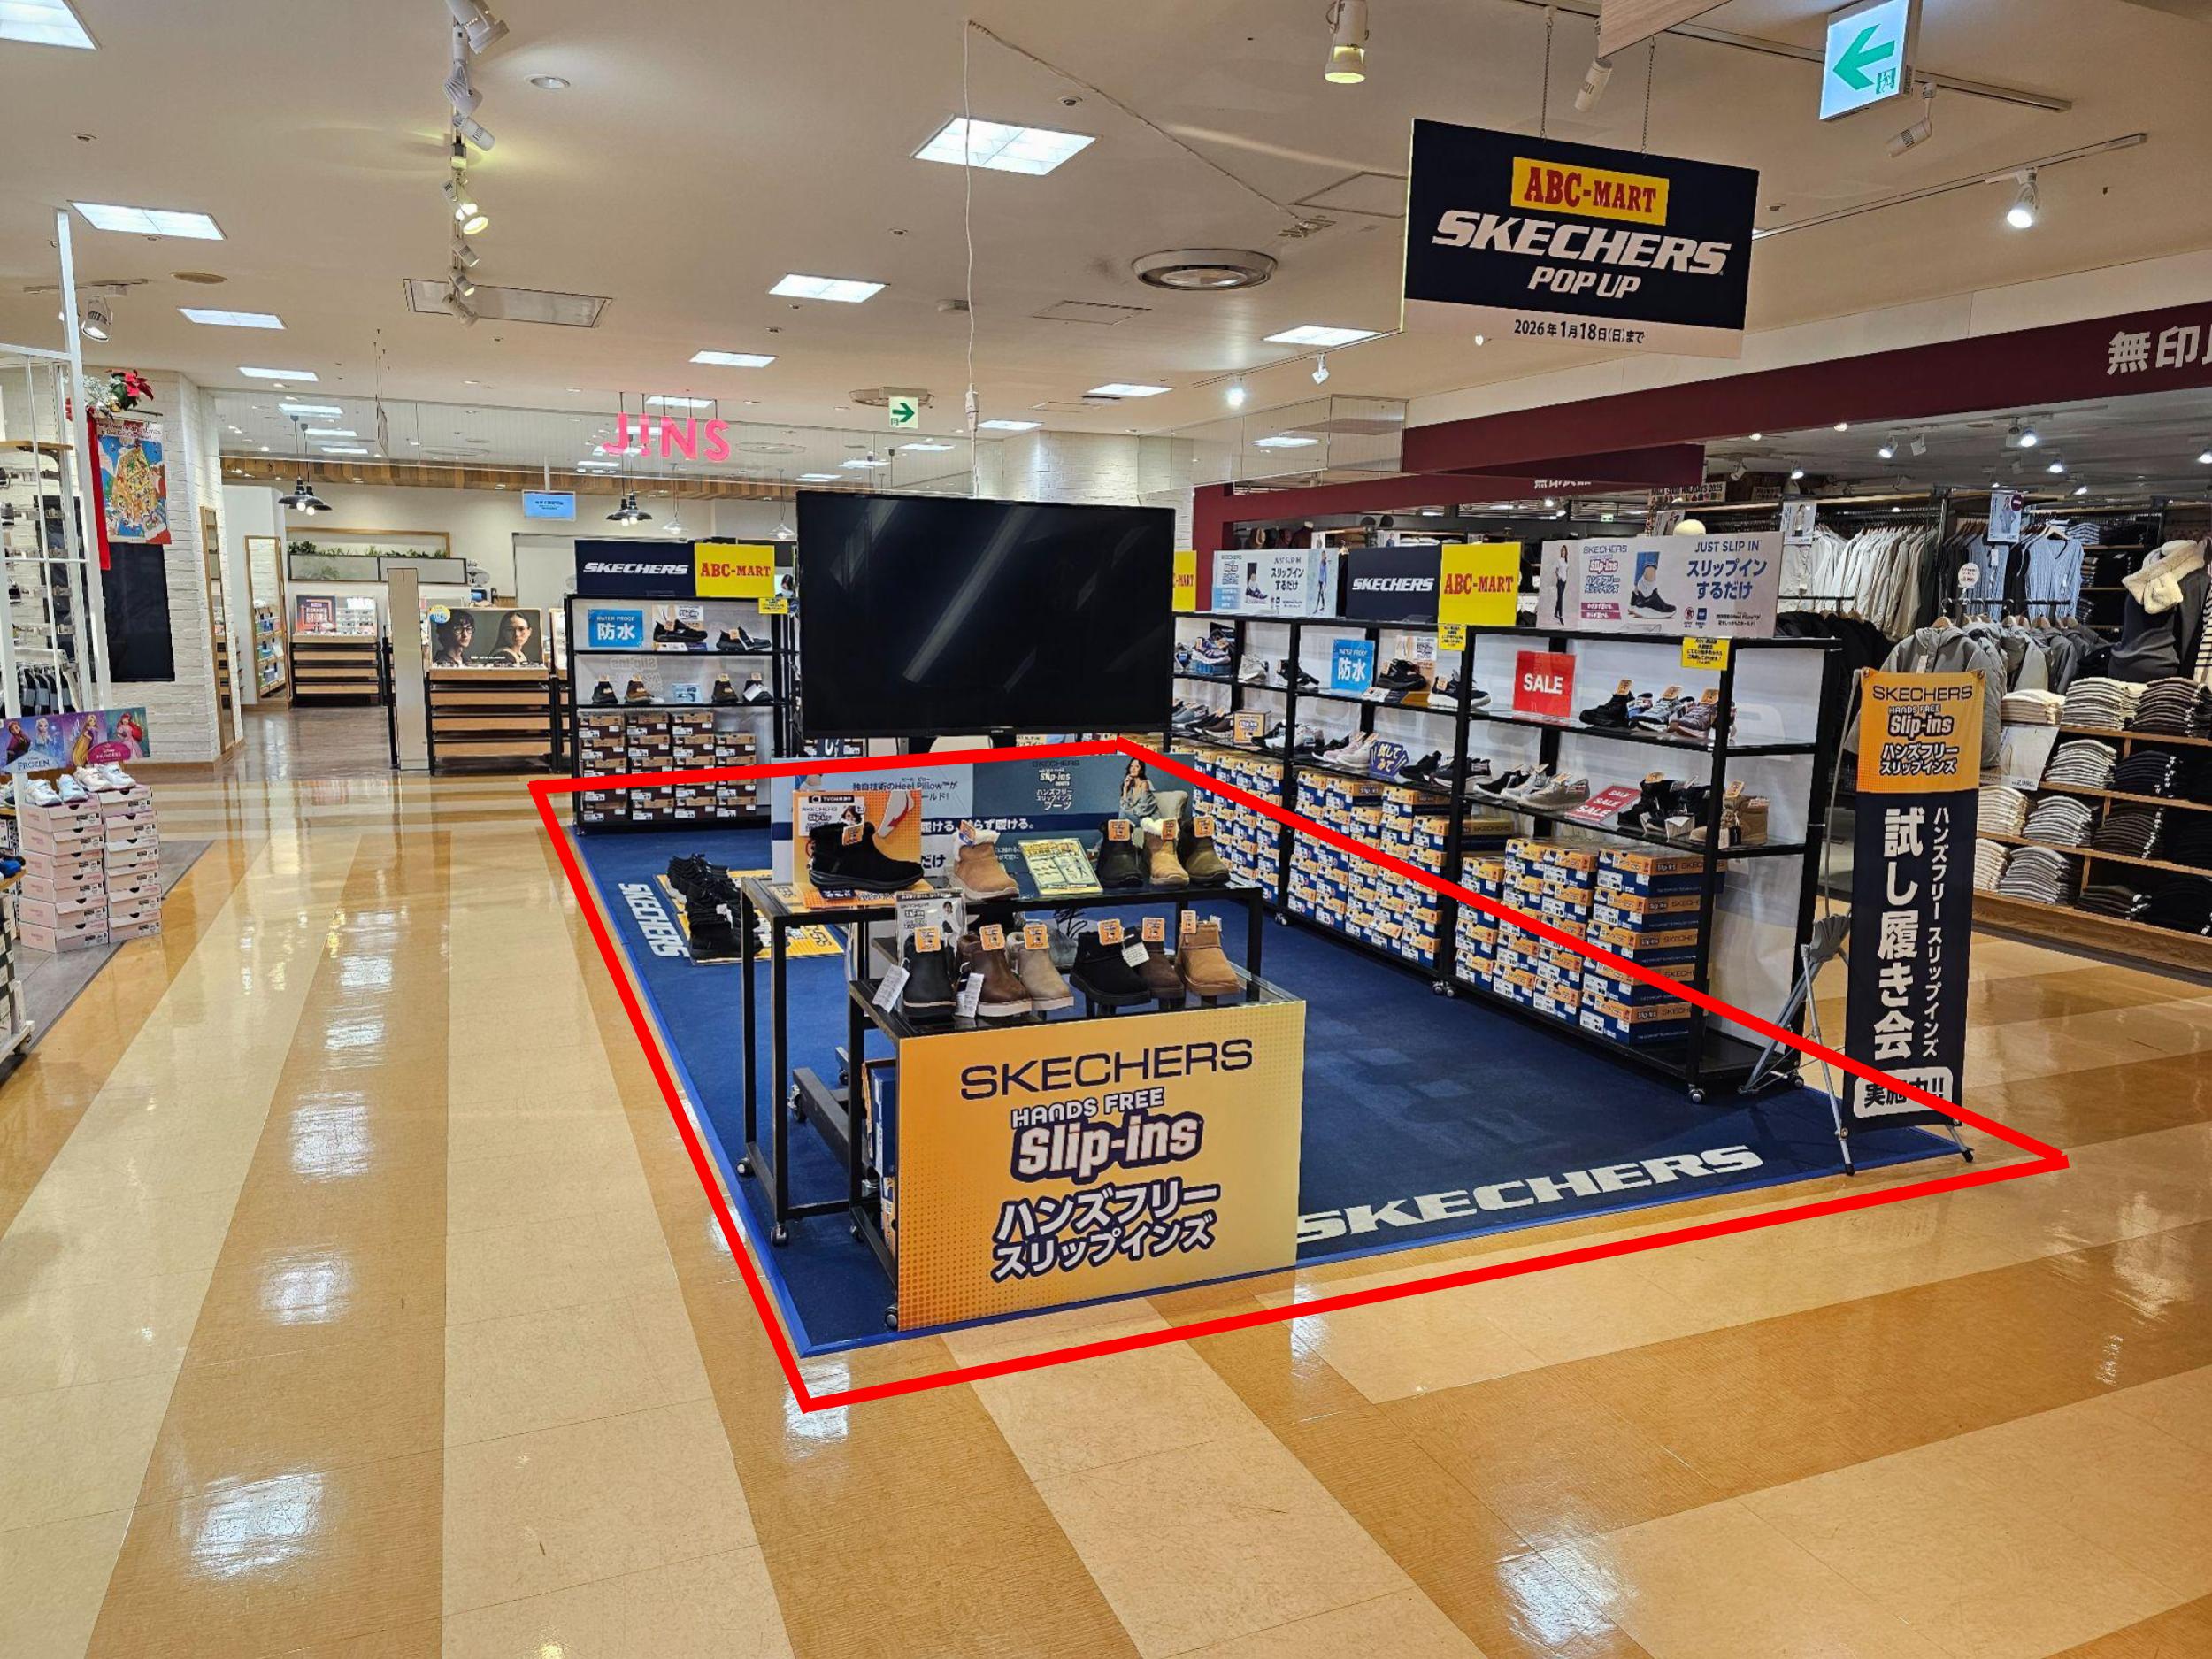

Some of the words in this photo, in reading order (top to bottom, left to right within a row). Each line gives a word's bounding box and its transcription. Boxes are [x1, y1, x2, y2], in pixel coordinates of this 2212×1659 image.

[1524, 166, 1656, 213] ABC-MART
[1432, 209, 1732, 275] SKECHERS
[1527, 266, 1596, 294] POP
[1598, 274, 1641, 299] UP
[2107, 324, 2212, 376] 無印
[1583, 544, 1628, 554] SKECHERS
[1694, 541, 1720, 553] JUST
[1722, 541, 1746, 552] SLIP
[1747, 540, 1761, 551] IN
[583, 562, 688, 575] SKECHERS
[701, 562, 771, 578] ABC-MART
[1687, 558, 1767, 578] スリップイン
[1352, 577, 1435, 592] SKECHERS
[1444, 572, 1514, 595] ABC-MART
[1696, 580, 1753, 601] するだけ
[597, 622, 636, 640] 防水
[1337, 657, 1367, 681] 防水
[1524, 672, 1563, 695] SALE
[1872, 685, 1973, 702] SKECHERS
[1888, 705, 1917, 714] HANDS
[1919, 703, 1942, 714] FREE
[1889, 714, 1953, 740] Slip-ins
[1881, 742, 1959, 760] ハンズフリー
[17, 758, 50, 772] FROZEN
[1880, 758, 1957, 775] スリップインズ
[1575, 805, 1612, 818] SALE
[1594, 797, 1621, 807] SALE
[1931, 807, 1950, 920] ハンズフリー
[618, 883, 691, 957] SKECHERS
[1873, 806, 1925, 1061] 試し履き会
[1922, 926, 1943, 1057] スリップインズ
[961, 1038, 1253, 1100] SKECHERS
[1011, 1098, 1097, 1129] HANDS
[1104, 1087, 1164, 1117] FREE
[1016, 1112, 1201, 1179] Slip-ins
[1297, 1145, 1763, 1243] SKECHERS
[996, 1179, 1219, 1240] ハンズフリー
[993, 1215, 1214, 1280] スリップインズ
